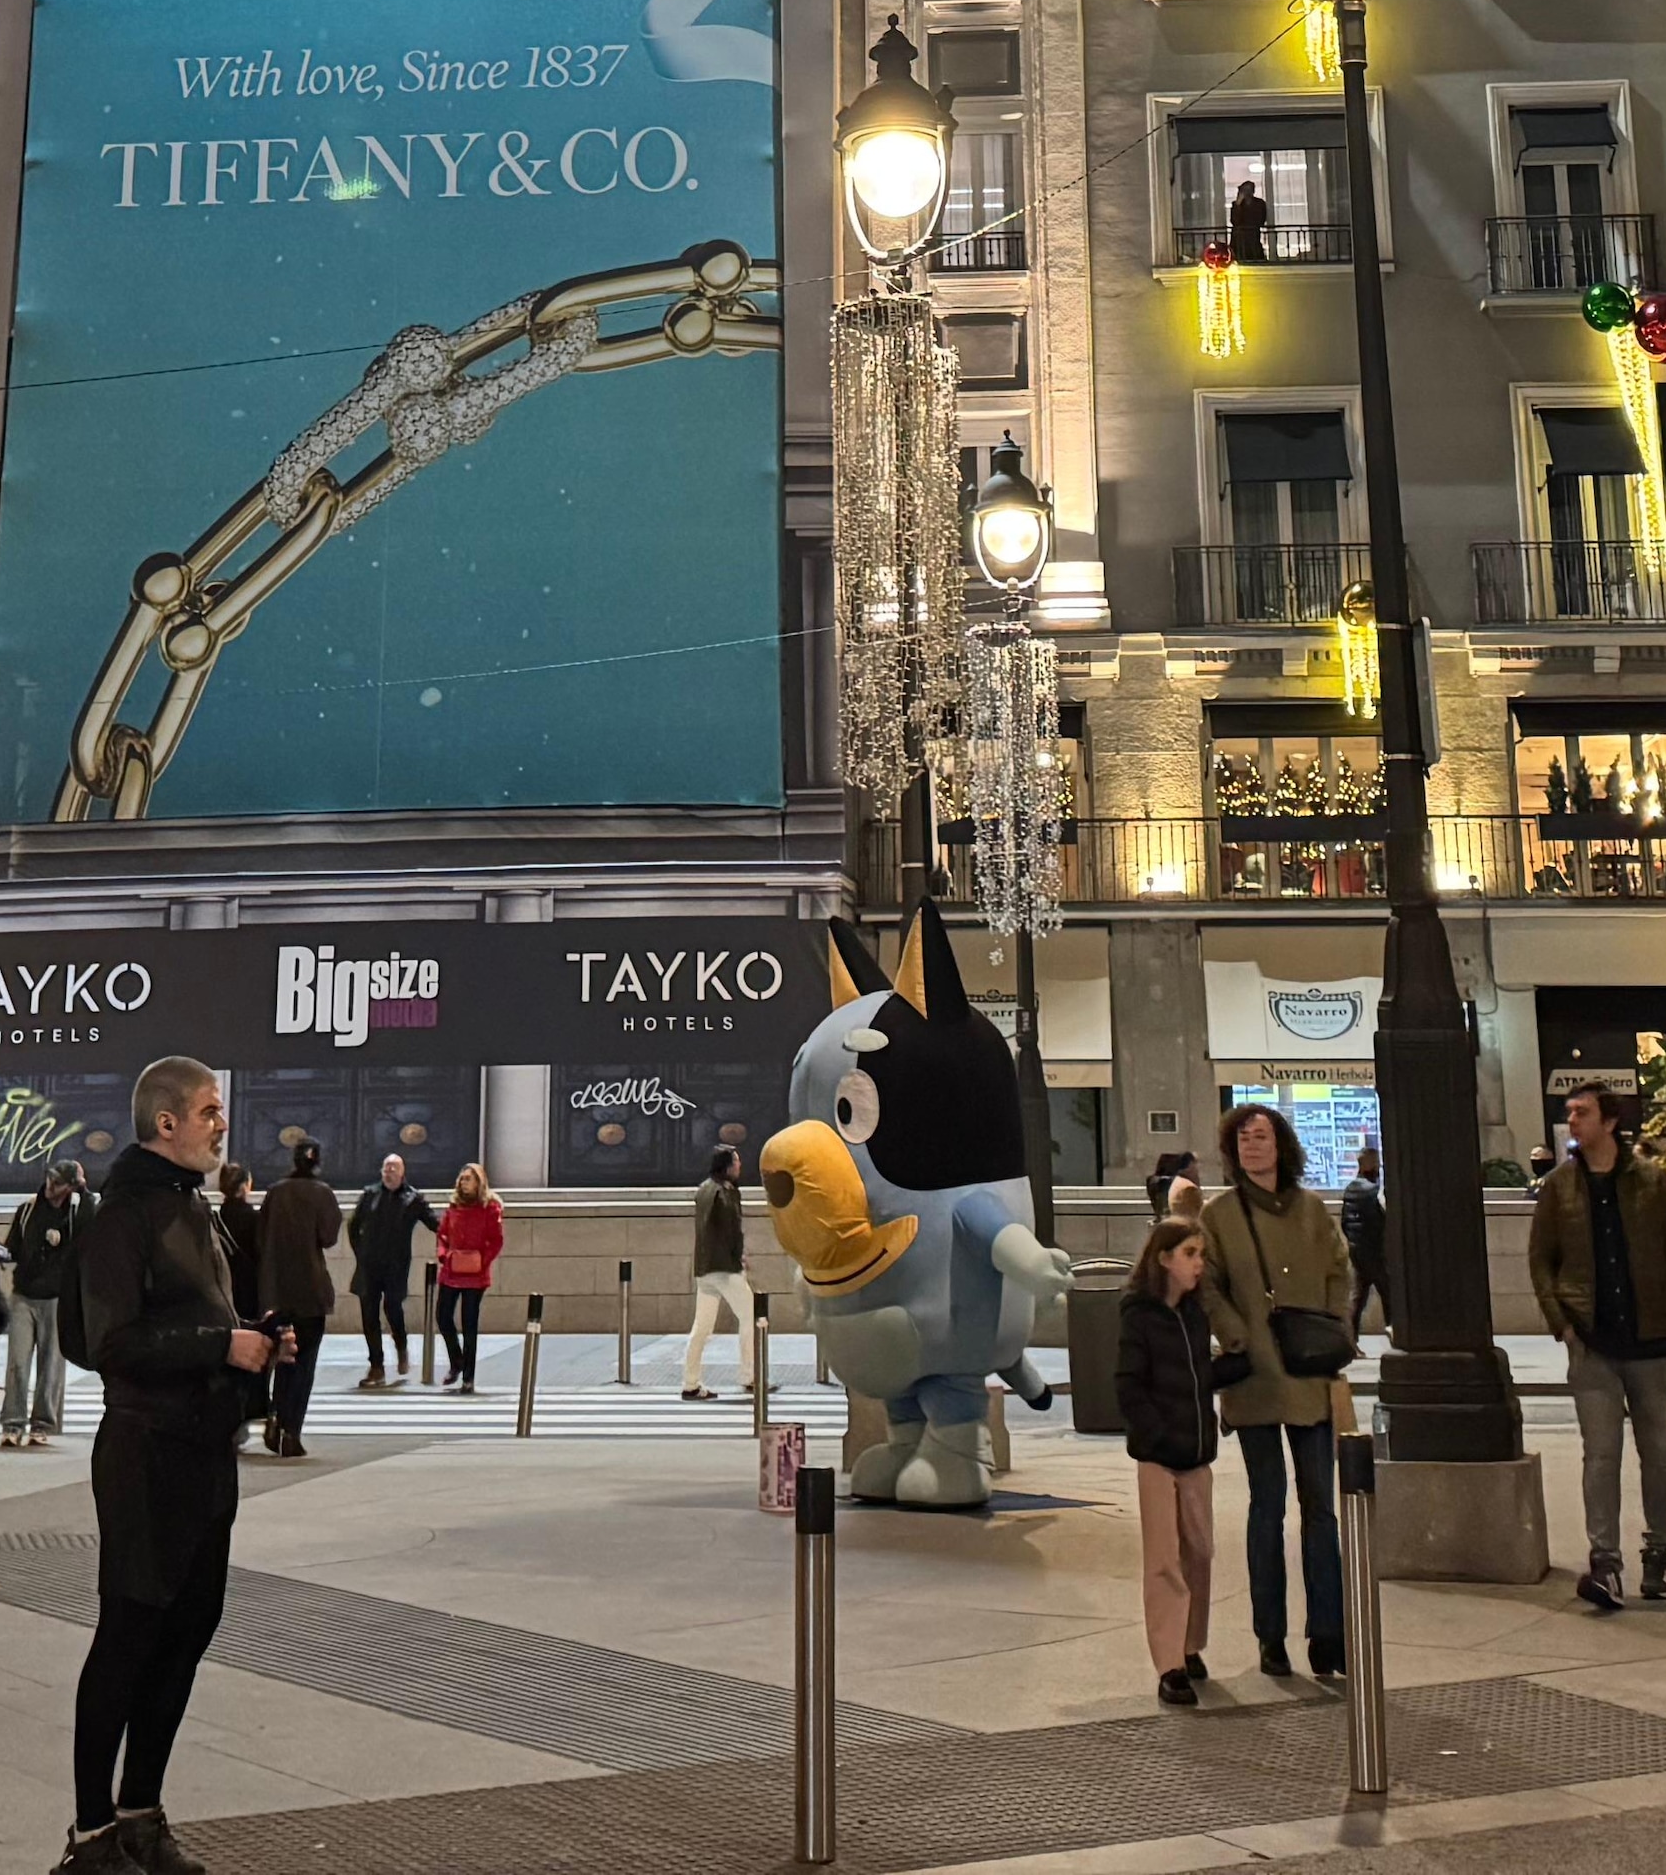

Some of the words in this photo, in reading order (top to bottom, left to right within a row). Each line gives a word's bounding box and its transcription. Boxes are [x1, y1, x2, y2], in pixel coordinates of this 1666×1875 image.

[175, 49, 282, 99] With
[296, 48, 384, 101] love,
[398, 49, 509, 93] Since
[521, 43, 630, 89] 1837
[565, 951, 783, 1003] TAYKO
[1284, 1004, 1349, 1018] Navarro
[622, 1015, 734, 1032] HOTELS
[1261, 1064, 1327, 1080] Navarro
